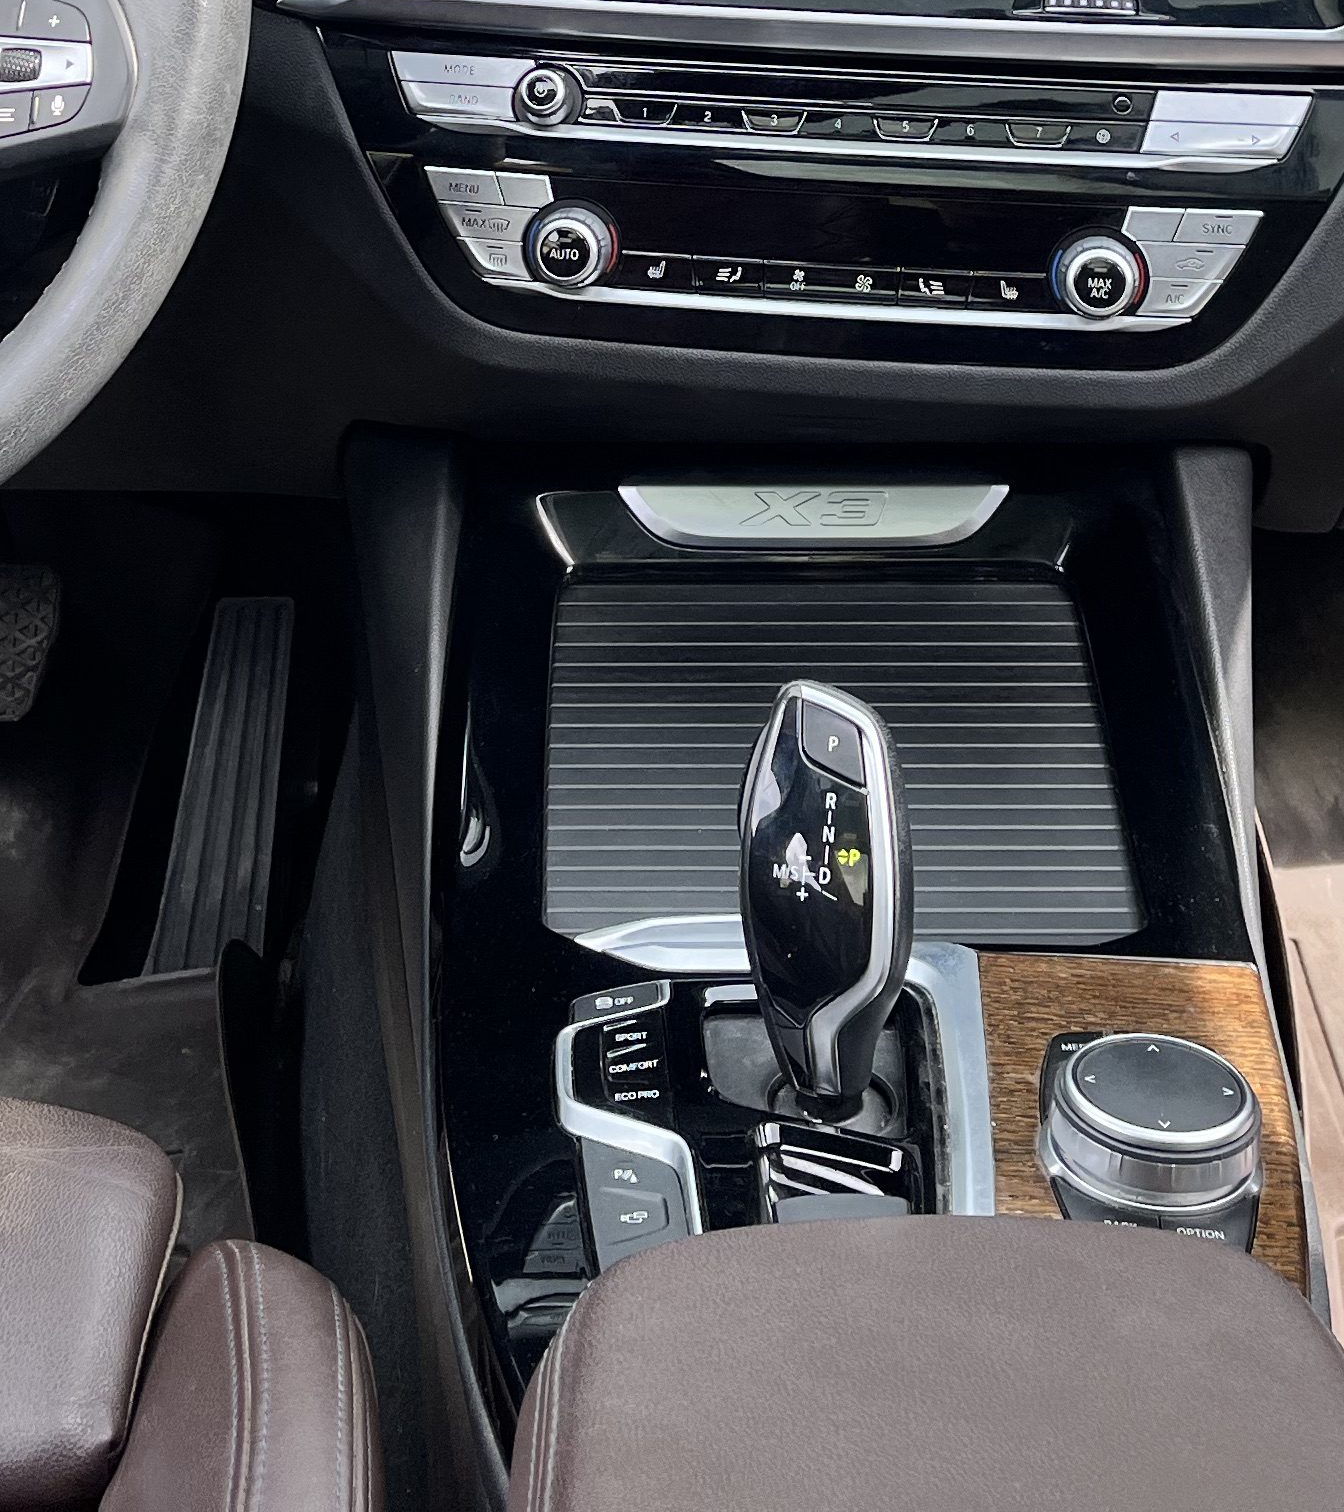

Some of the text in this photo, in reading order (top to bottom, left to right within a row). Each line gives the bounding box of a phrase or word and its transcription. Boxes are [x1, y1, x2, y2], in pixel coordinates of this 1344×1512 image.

[641, 107, 648, 118] 1
[703, 111, 711, 122] 2
[770, 114, 778, 126] 3
[834, 118, 842, 129] 4
[902, 120, 910, 133] 5
[966, 124, 974, 137] 6
[448, 182, 480, 195] MENU
[461, 216, 486, 227] MAX
[1202, 222, 1233, 236] SYNC
[549, 247, 580, 261] AUTO
[1088, 277, 1113, 290] MAX
[1090, 287, 1109, 300] A/C
[1165, 292, 1185, 305] A/C
[739, 490, 889, 527] X3
[828, 736, 839, 752] P
[826, 792, 837, 809] R
[823, 826, 836, 843] N
[609, 1059, 659, 1074] COMFORT
[615, 1090, 660, 1102] ECO PRO
